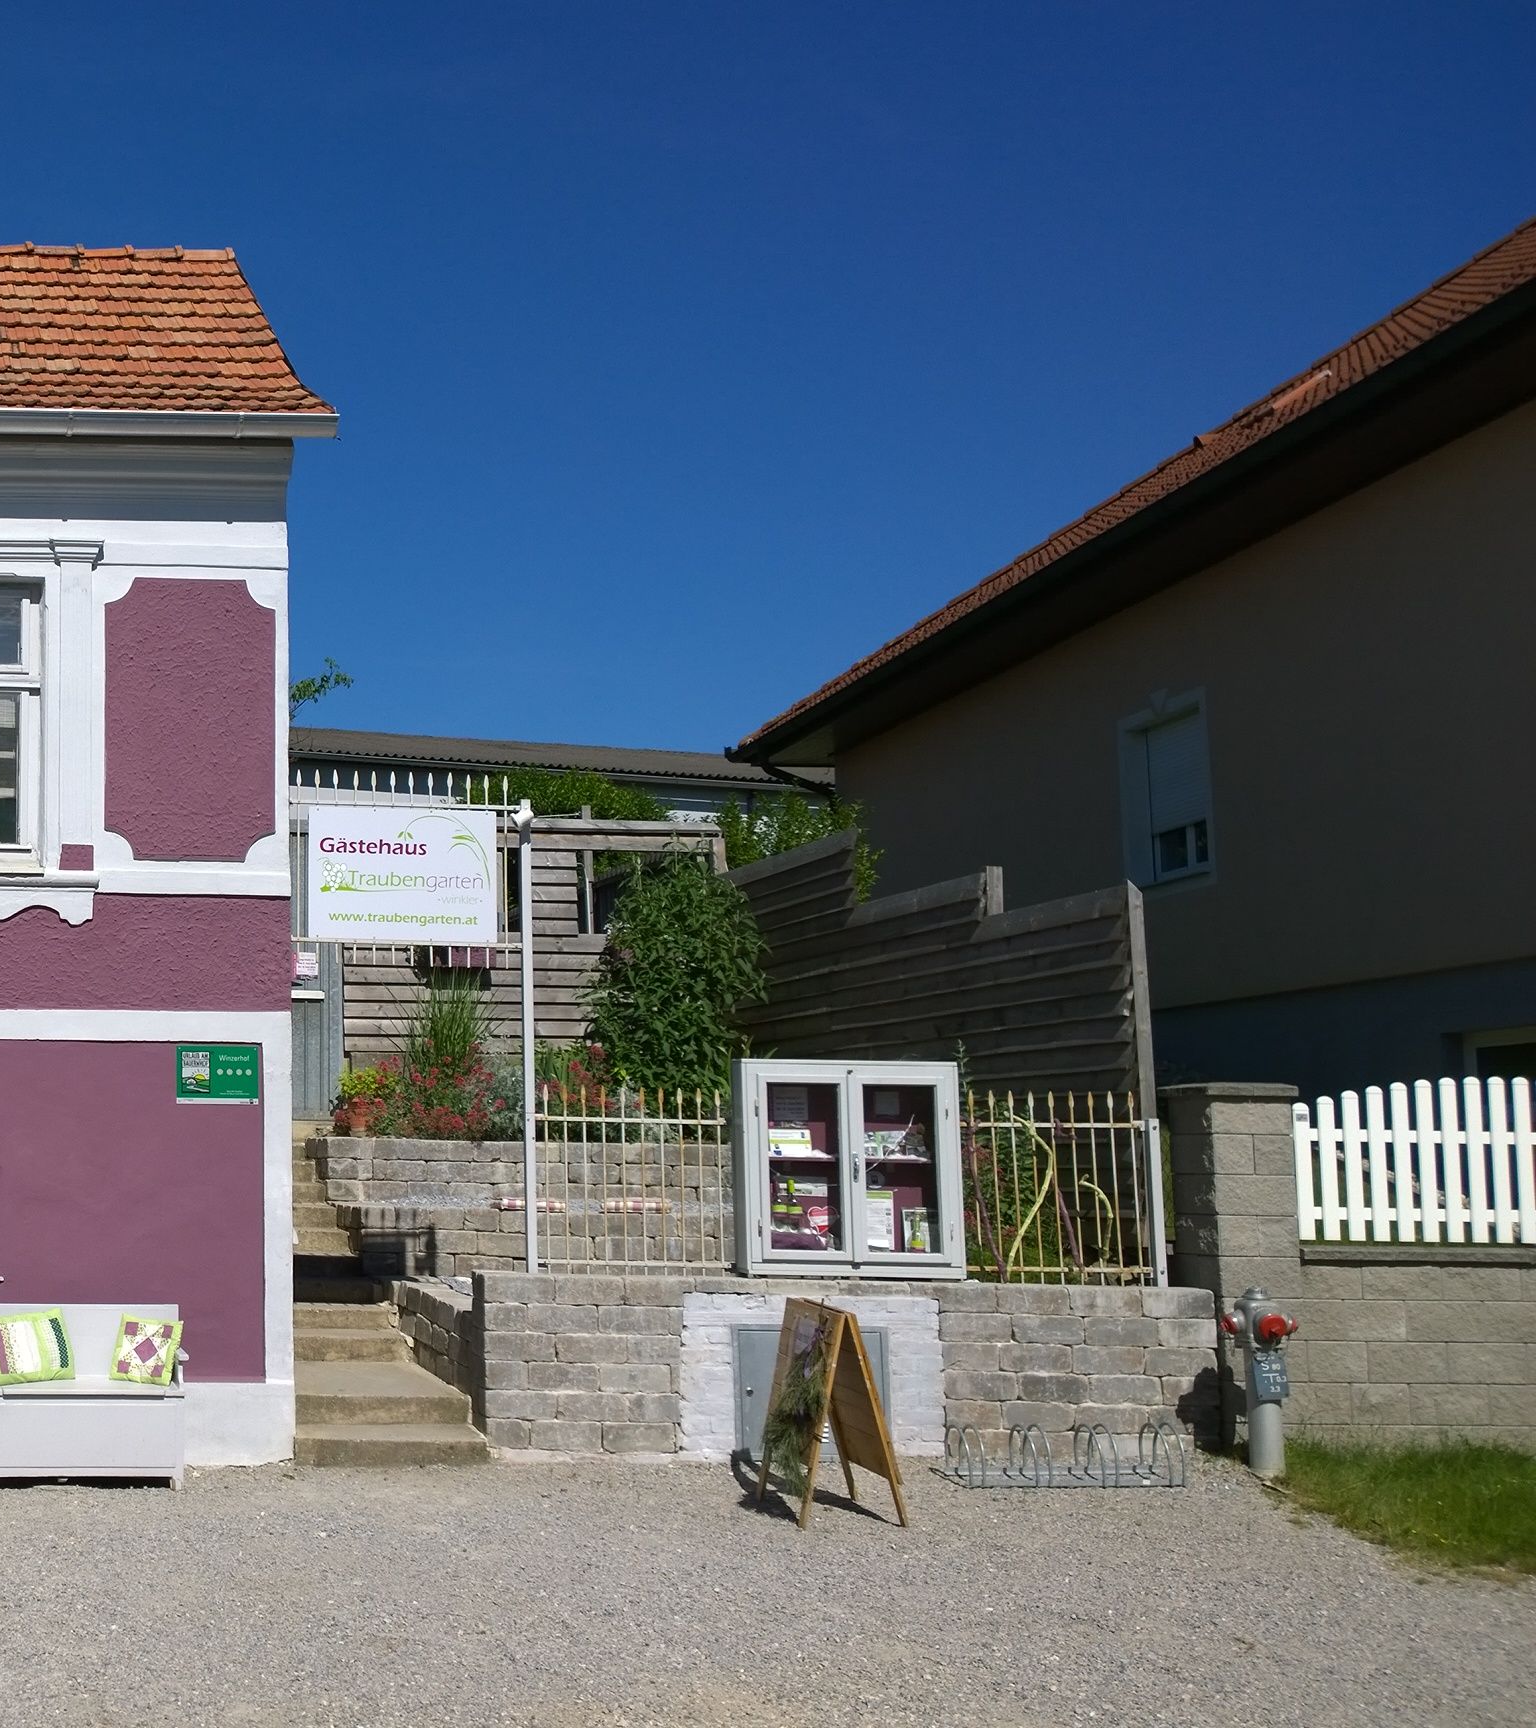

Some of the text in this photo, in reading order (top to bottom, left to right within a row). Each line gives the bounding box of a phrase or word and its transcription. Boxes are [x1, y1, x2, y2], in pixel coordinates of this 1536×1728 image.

[320, 837, 427, 856] Gästehaus
[348, 870, 484, 892] Traubengarten
[328, 911, 478, 927] www.traubengarten.at
